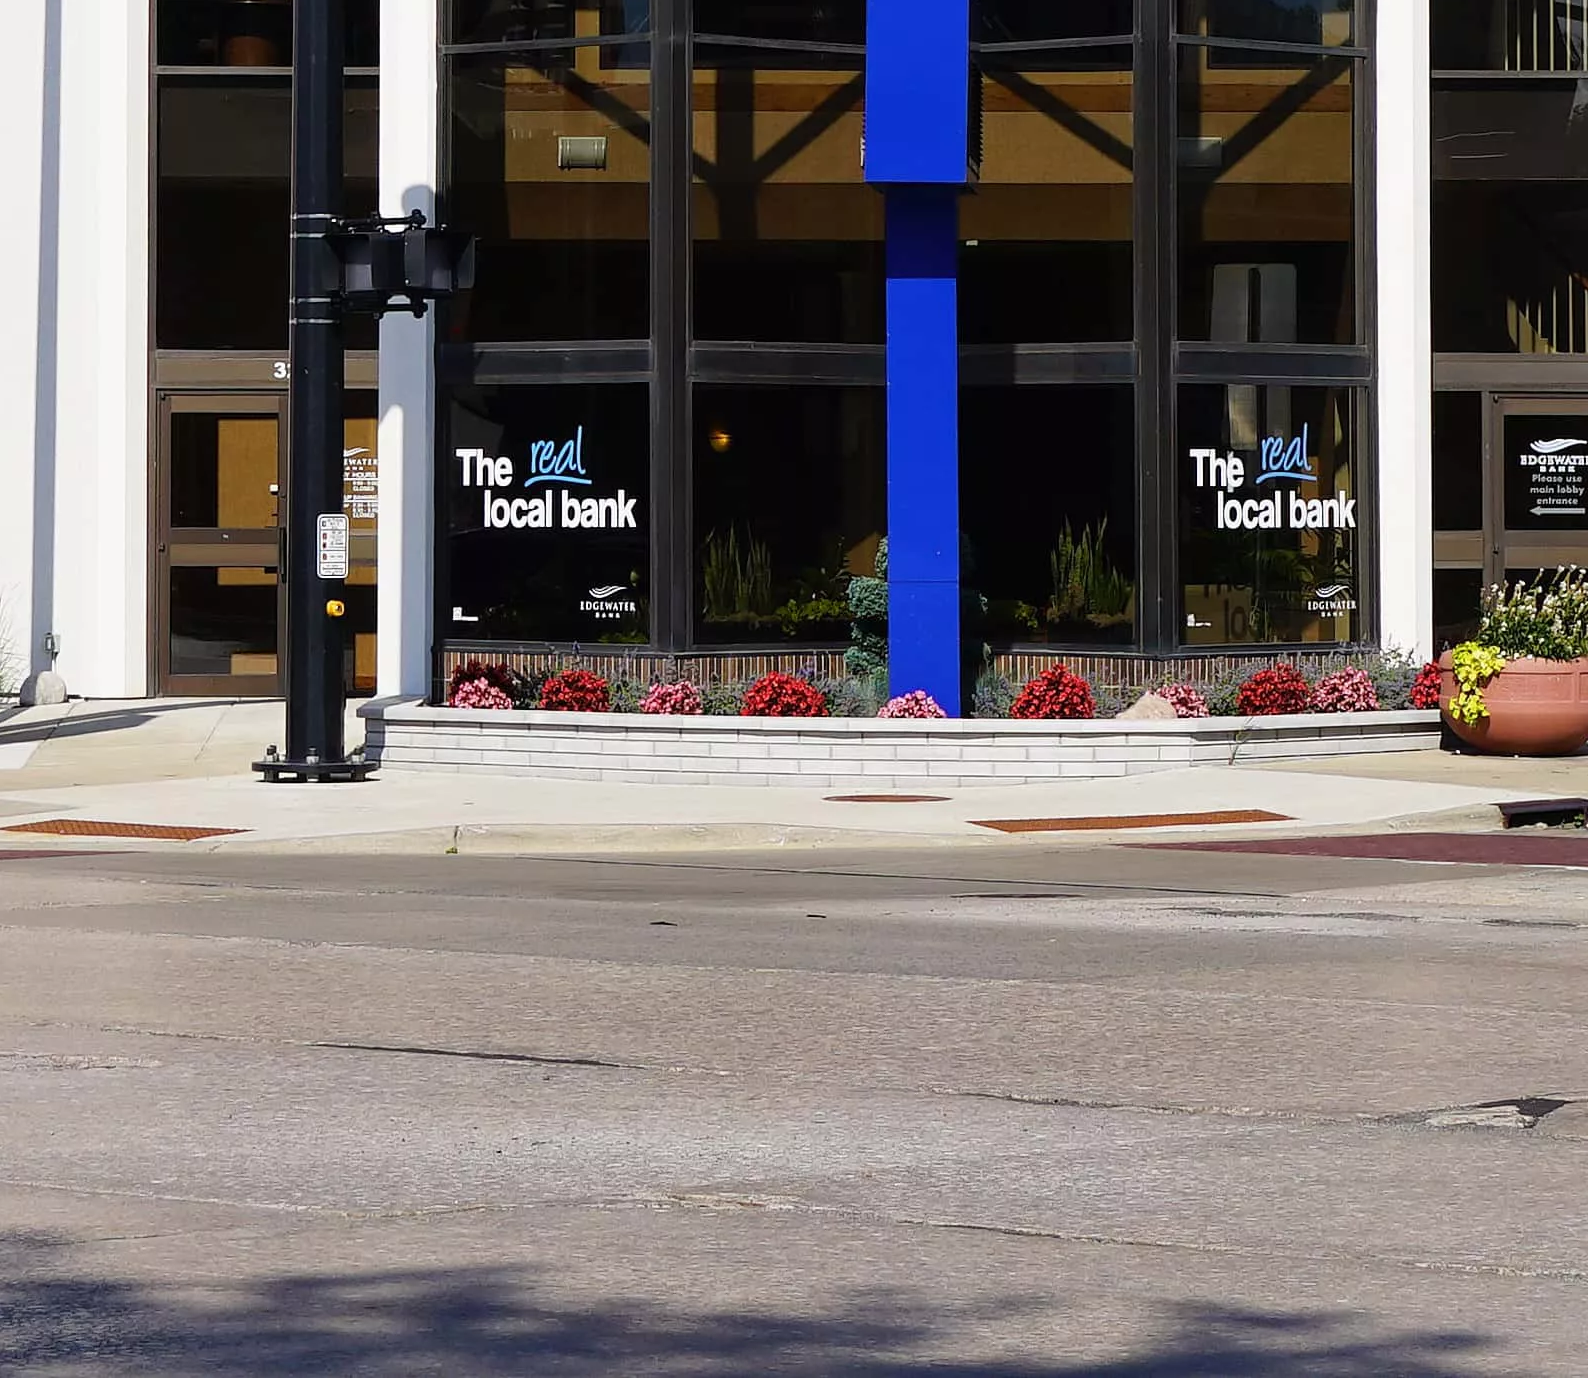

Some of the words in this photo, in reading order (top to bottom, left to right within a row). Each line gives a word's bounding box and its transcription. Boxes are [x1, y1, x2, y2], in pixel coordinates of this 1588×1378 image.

[456, 448, 513, 487] The
[531, 425, 586, 475] real
[1189, 449, 1244, 488] The
[1262, 422, 1312, 471] real
[1539, 465, 1576, 473] BANK
[1532, 474, 1563, 482] Please
[1530, 485, 1554, 494] main
[1557, 484, 1585, 497] lobby
[1536, 497, 1579, 505] entrance
[484, 489, 553, 528] local
[561, 489, 637, 528] bank
[1217, 490, 1282, 529] local
[1289, 490, 1356, 529] bank
[580, 601, 636, 612] EDGEWATER
[1307, 600, 1357, 611] EDGEWATER
